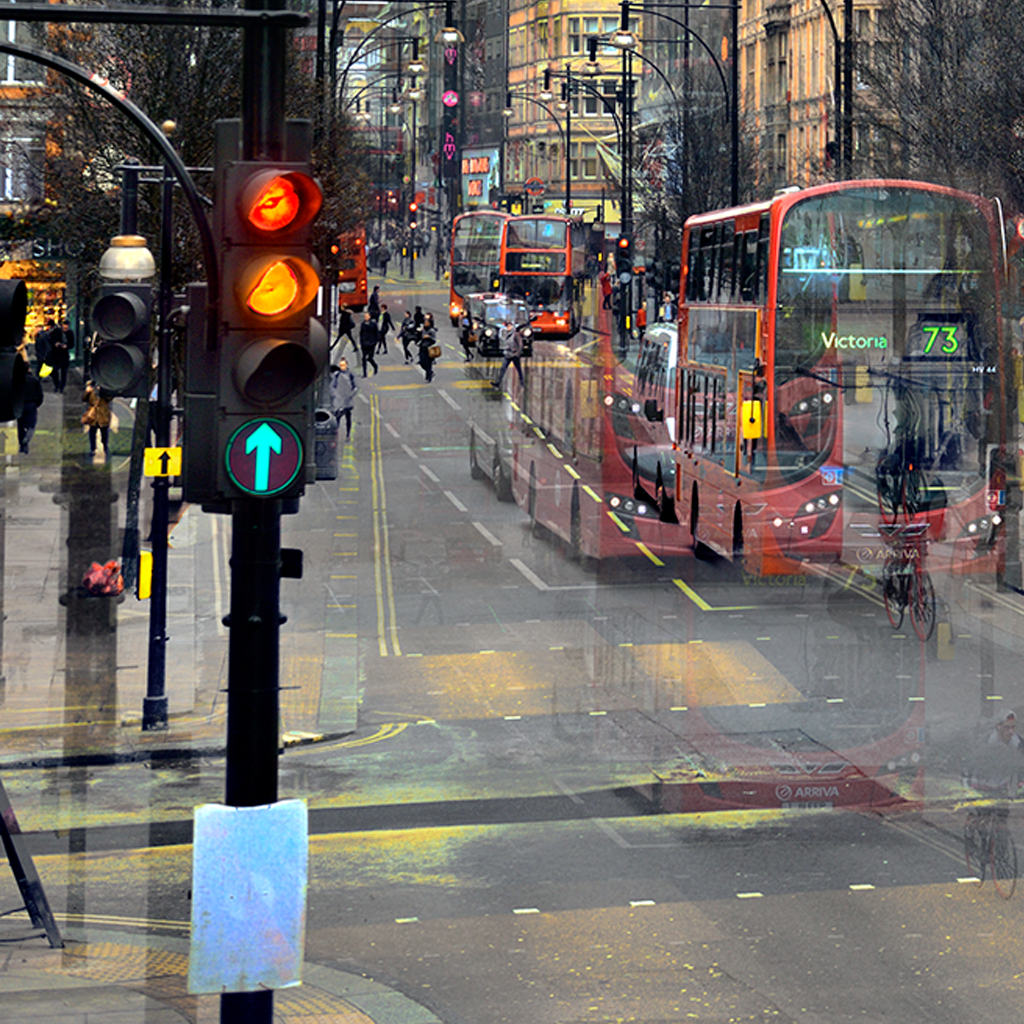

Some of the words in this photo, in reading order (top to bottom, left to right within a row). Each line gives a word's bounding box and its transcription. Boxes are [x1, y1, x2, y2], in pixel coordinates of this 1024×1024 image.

[443, 131, 456, 161] hmv
[821, 332, 888, 349] Victoria
[922, 326, 959, 354] 73
[794, 785, 840, 798] ARRIVA
